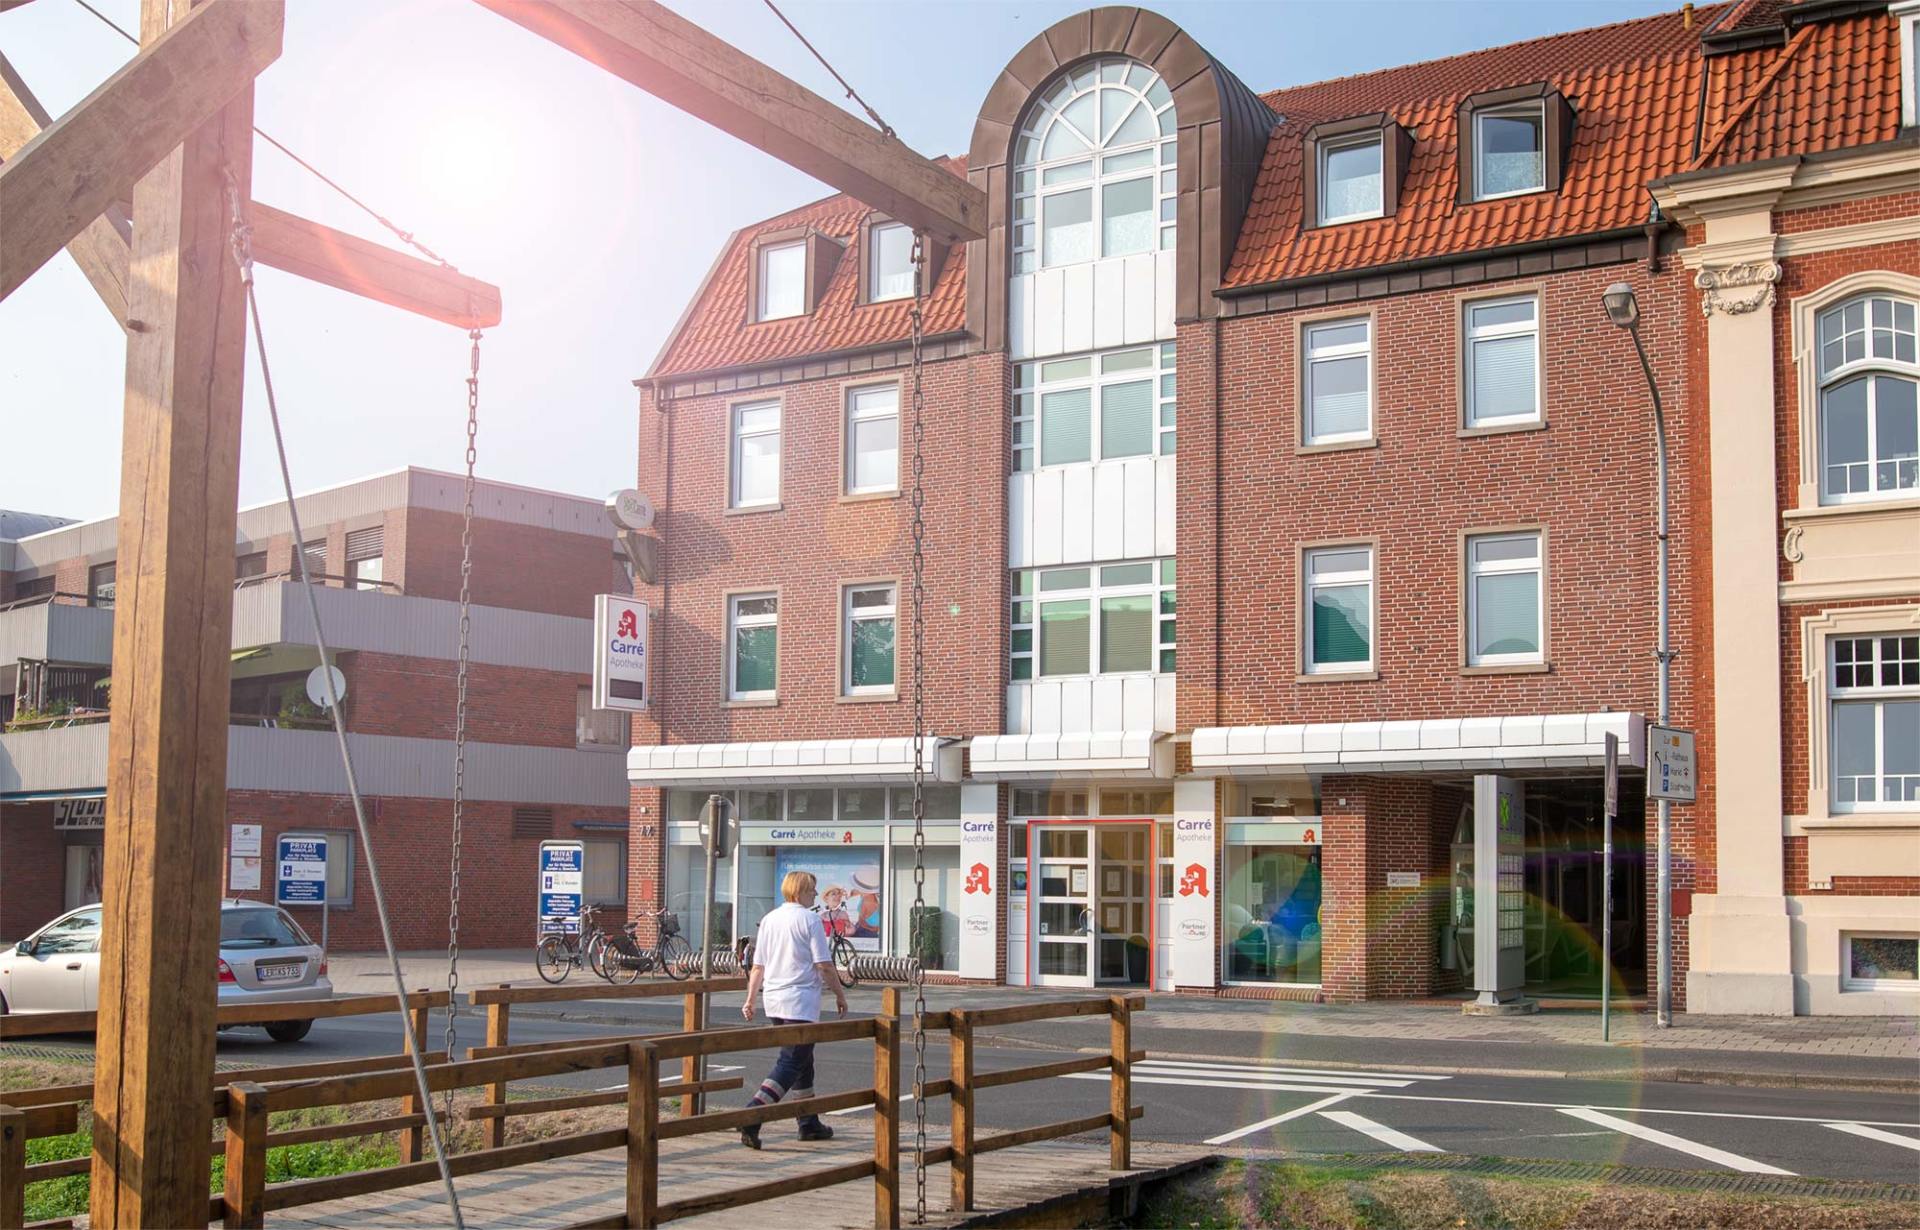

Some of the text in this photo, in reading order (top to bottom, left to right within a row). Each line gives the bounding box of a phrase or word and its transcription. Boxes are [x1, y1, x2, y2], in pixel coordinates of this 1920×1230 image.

[610, 639, 645, 656] Carré
[609, 657, 645, 670] Apotheke
[963, 820, 995, 832] Carré
[1176, 818, 1213, 831] Carré
[770, 829, 796, 839] Carré
[797, 830, 836, 840] Apotheke
[962, 834, 995, 843] Apotheke
[1176, 833, 1213, 842] Apotheke
[550, 849, 574, 857] PRIVAT
